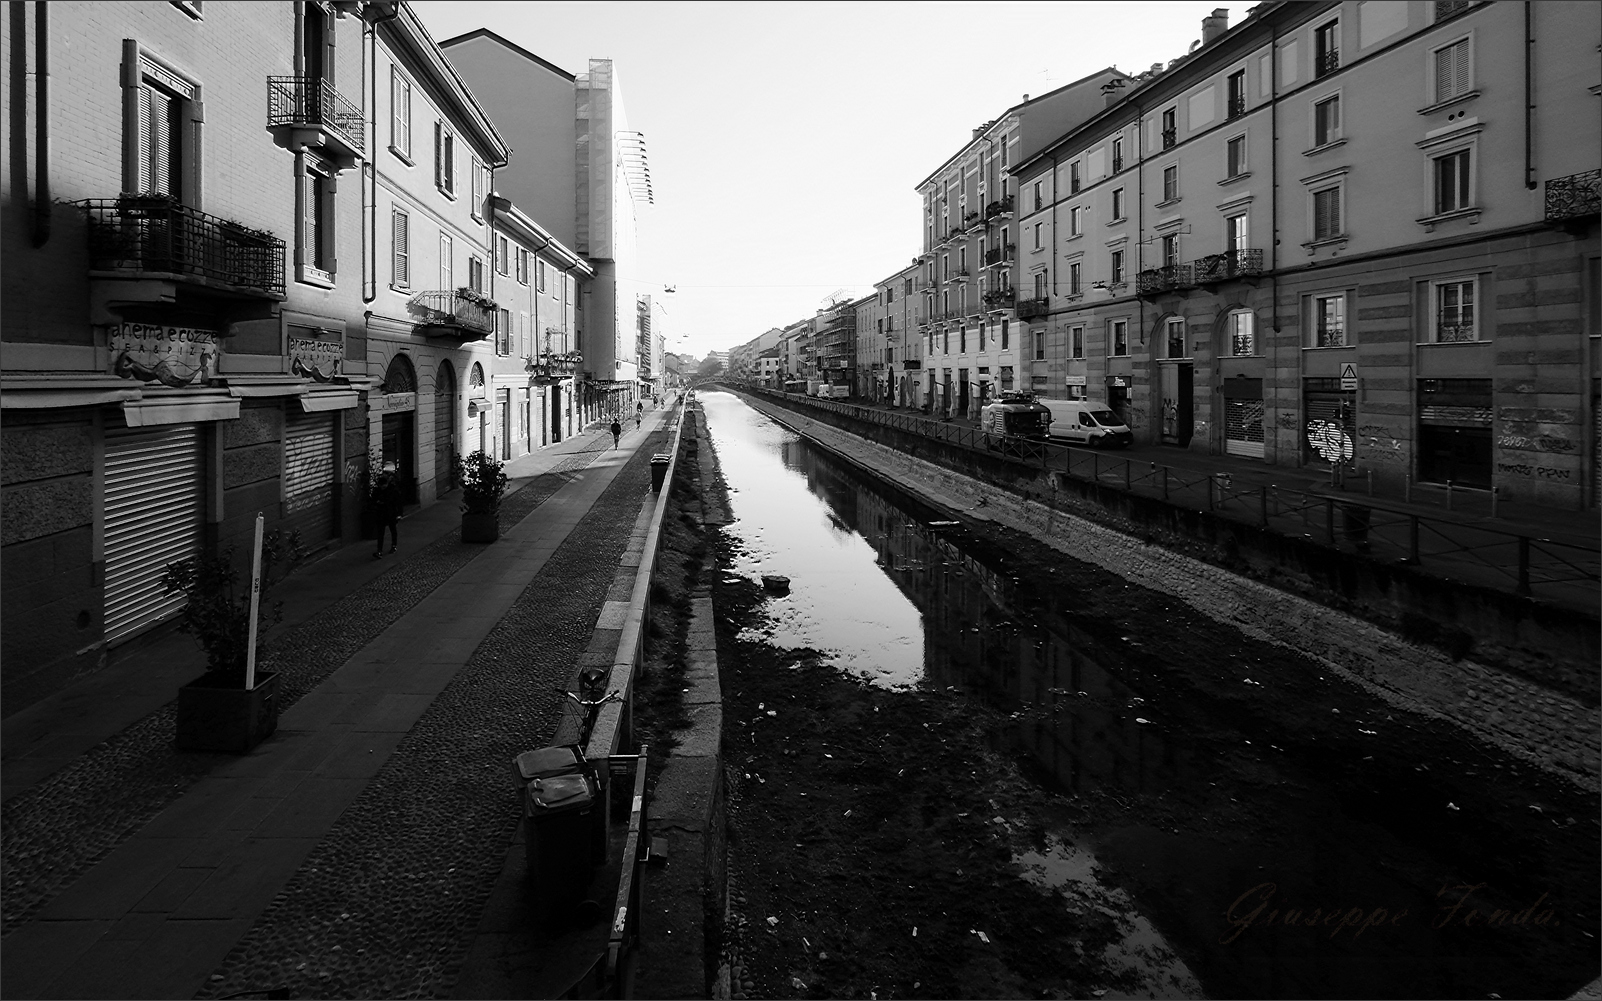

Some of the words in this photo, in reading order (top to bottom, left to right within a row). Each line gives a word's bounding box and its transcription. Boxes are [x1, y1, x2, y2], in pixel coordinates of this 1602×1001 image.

[112, 323, 165, 341] anema
[167, 328, 177, 342] e
[179, 329, 219, 344] cozze
[109, 342, 145, 353] SEA
